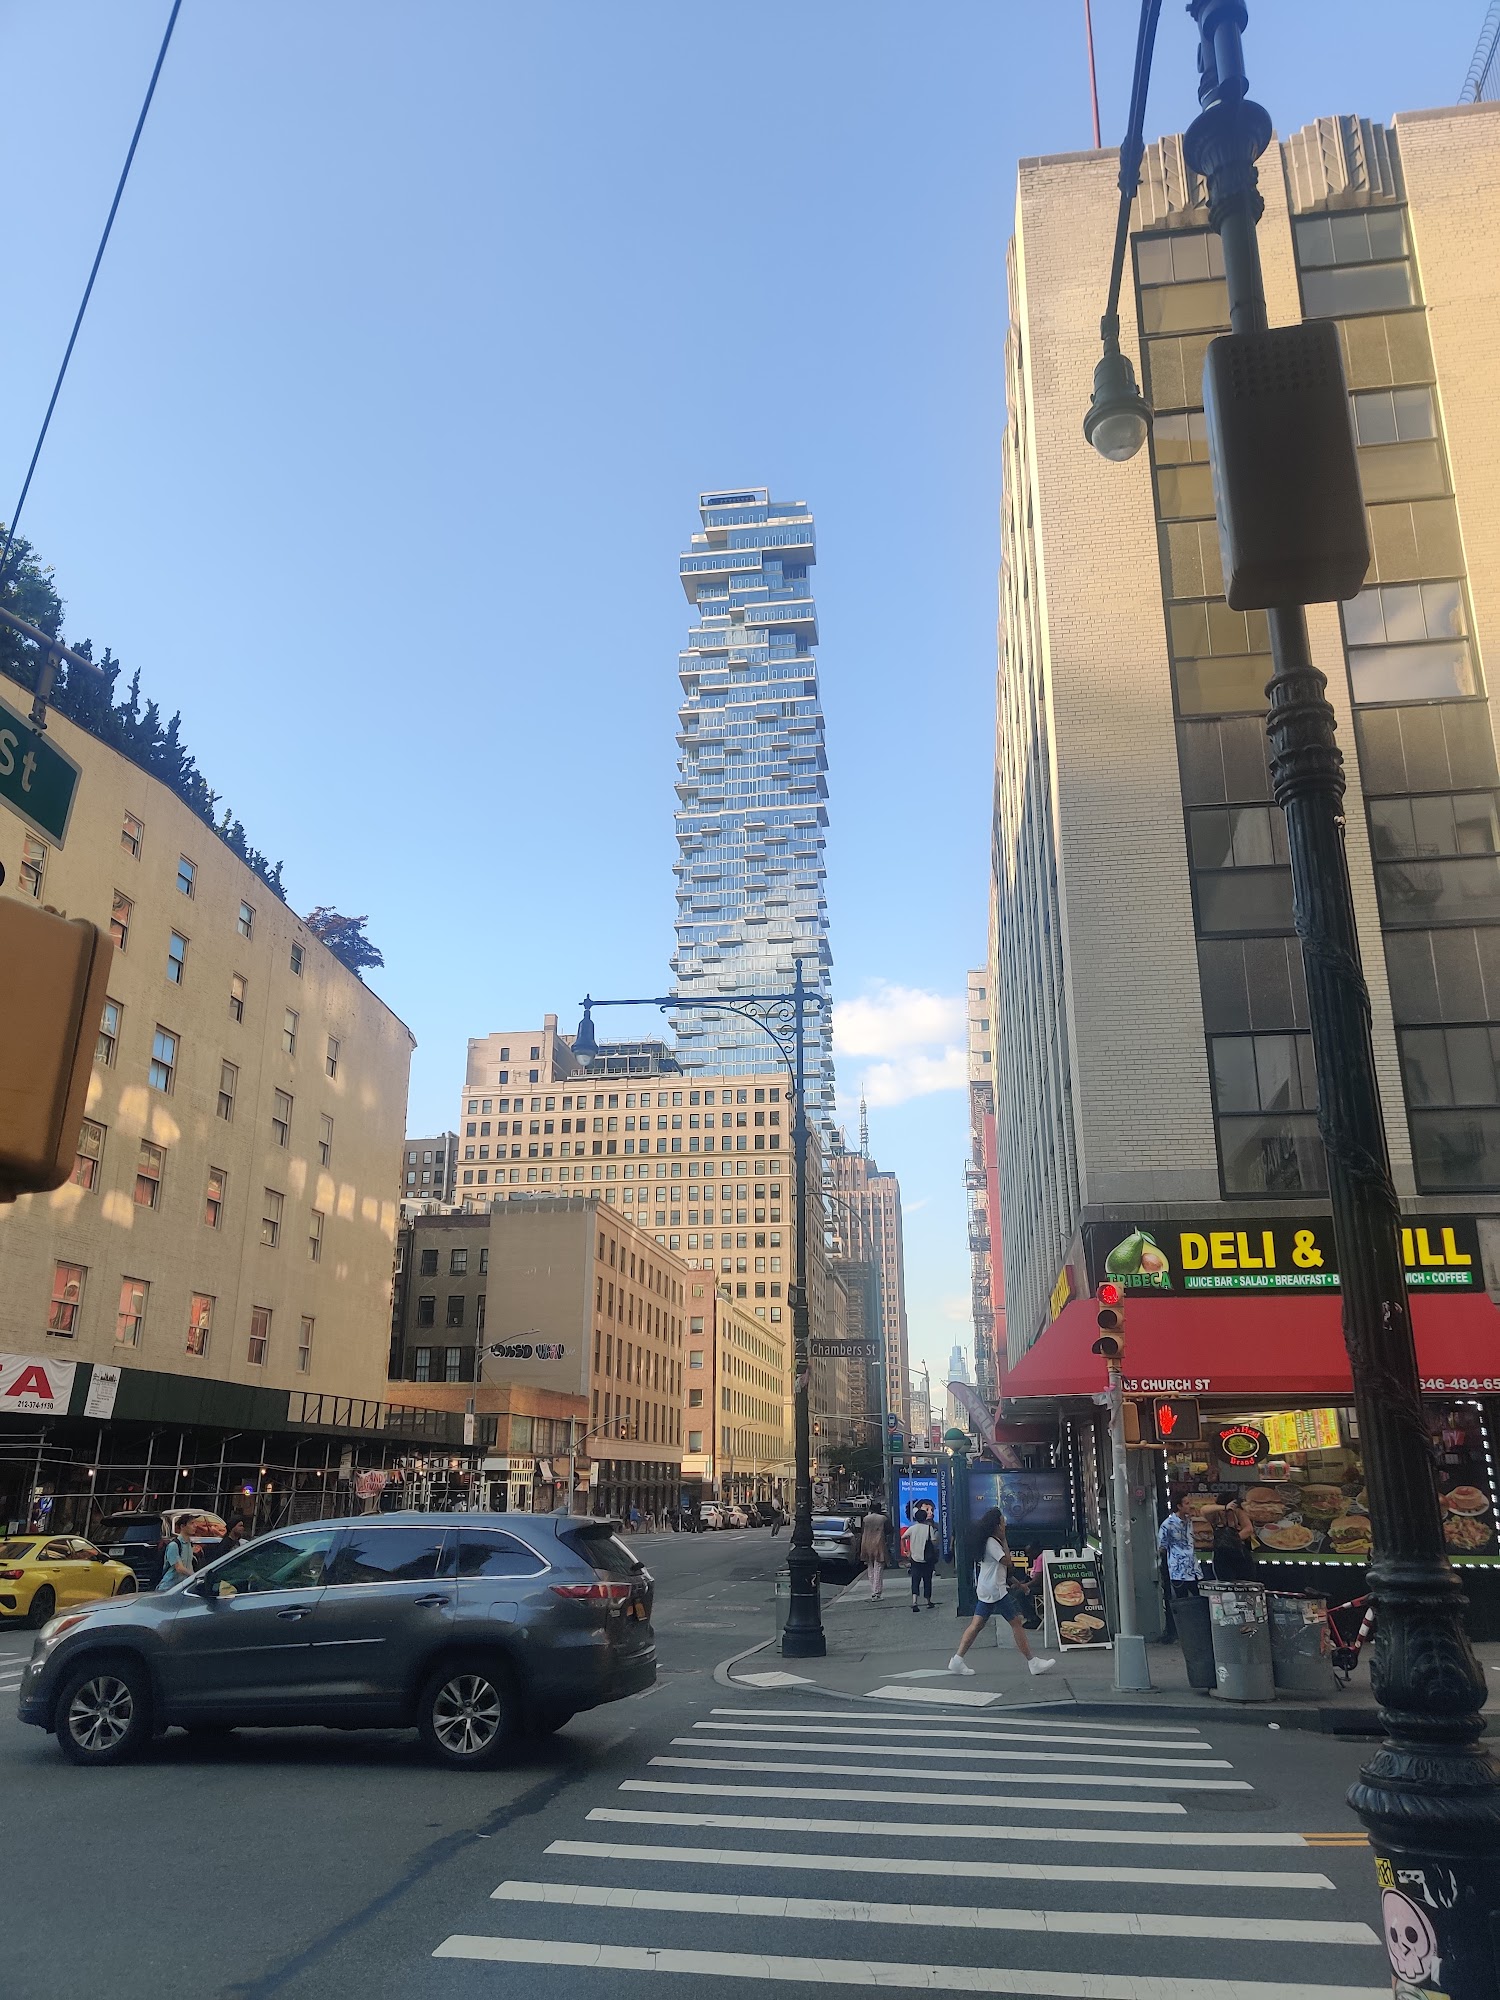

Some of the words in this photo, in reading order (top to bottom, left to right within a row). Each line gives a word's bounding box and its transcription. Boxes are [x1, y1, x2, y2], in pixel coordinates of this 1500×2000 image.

[0, 728, 37, 792] St
[1180, 1231, 1276, 1270] DELI
[1292, 1229, 1325, 1268] &
[1106, 1271, 1173, 1290] TRIBECA
[1188, 1276, 1213, 1287] JUICE
[1214, 1275, 1232, 1286] BAR
[1239, 1275, 1269, 1286] SALAD
[1275, 1273, 1327, 1285] BREAKFAST
[1432, 1272, 1469, 1283] COFFEE
[812, 1343, 862, 1356] Chambers
[866, 1344, 876, 1356] St
[1141, 1379, 1192, 1390] CHURCH
[1194, 1379, 1211, 1390] ST
[1057, 1563, 1087, 1571] TRIBECA
